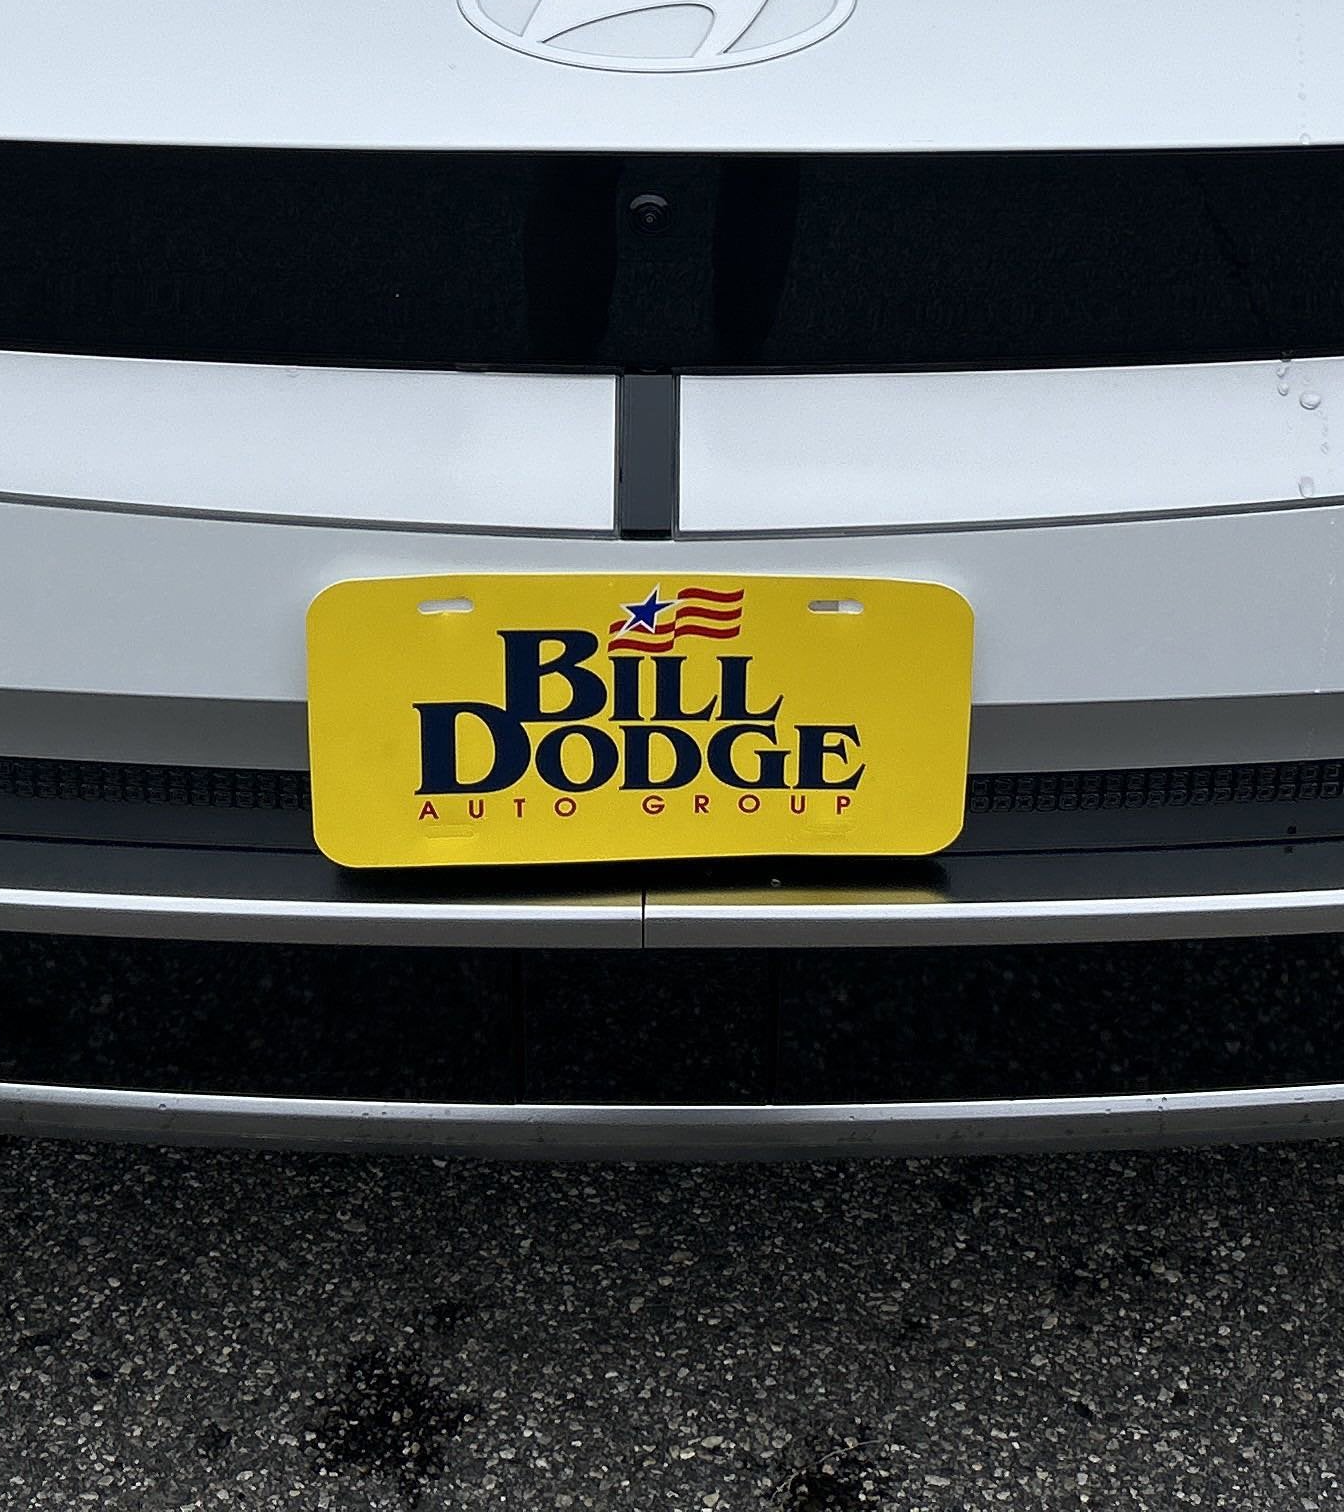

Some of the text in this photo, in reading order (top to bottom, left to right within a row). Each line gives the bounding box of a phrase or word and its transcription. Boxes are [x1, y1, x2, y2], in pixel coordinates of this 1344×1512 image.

[496, 628, 784, 723] BILL
[412, 701, 866, 796] DODGE
[418, 793, 852, 821] AUTO GROUP
